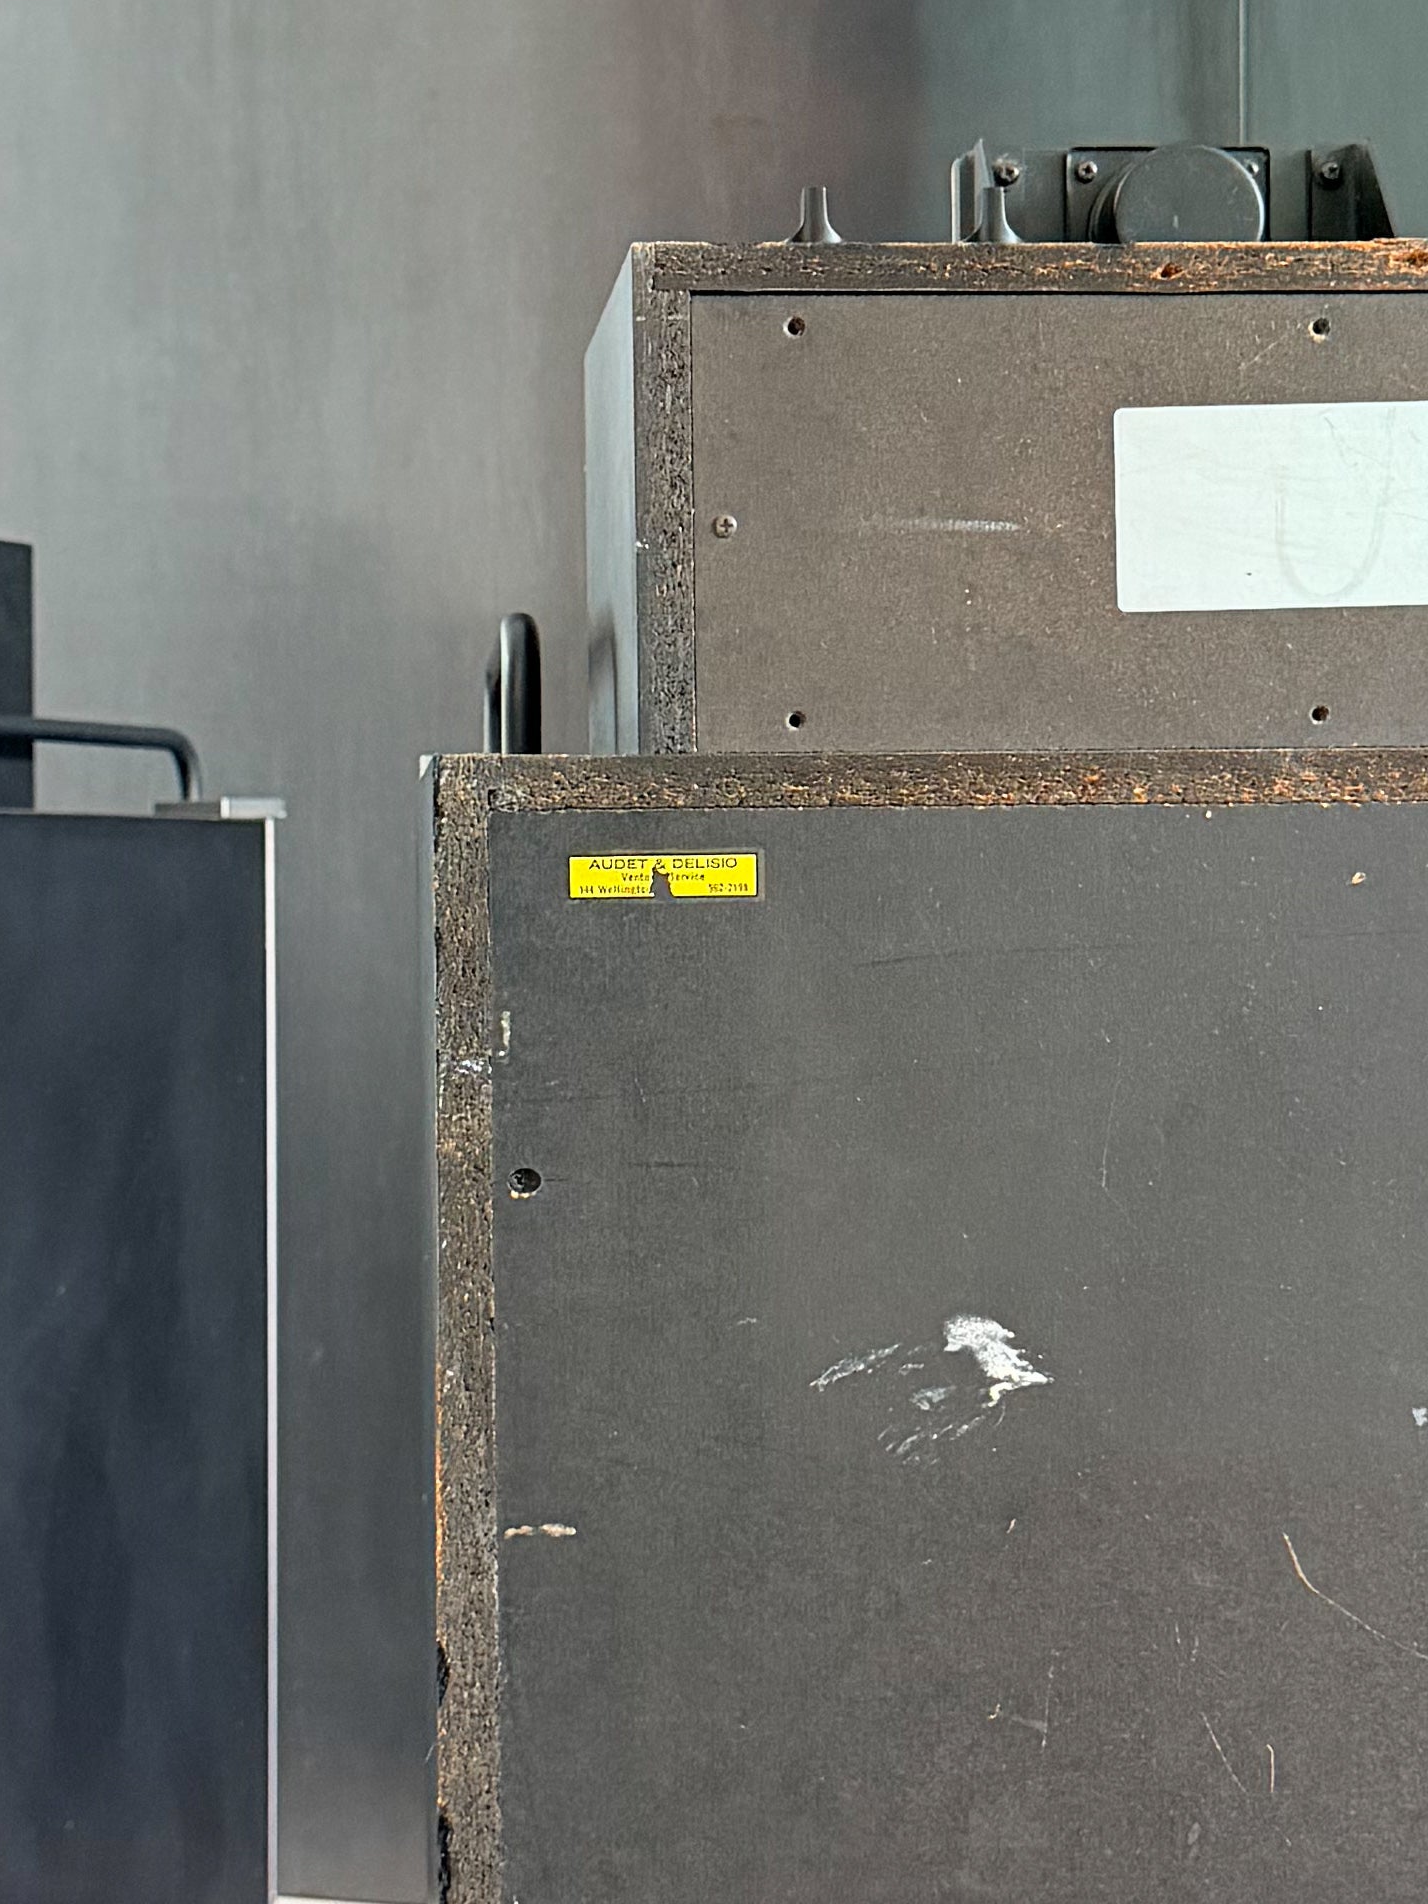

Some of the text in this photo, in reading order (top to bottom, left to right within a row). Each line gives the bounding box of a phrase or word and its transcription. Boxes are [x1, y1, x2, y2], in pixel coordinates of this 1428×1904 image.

[589, 857, 738, 870] AUDET & DELISIO
